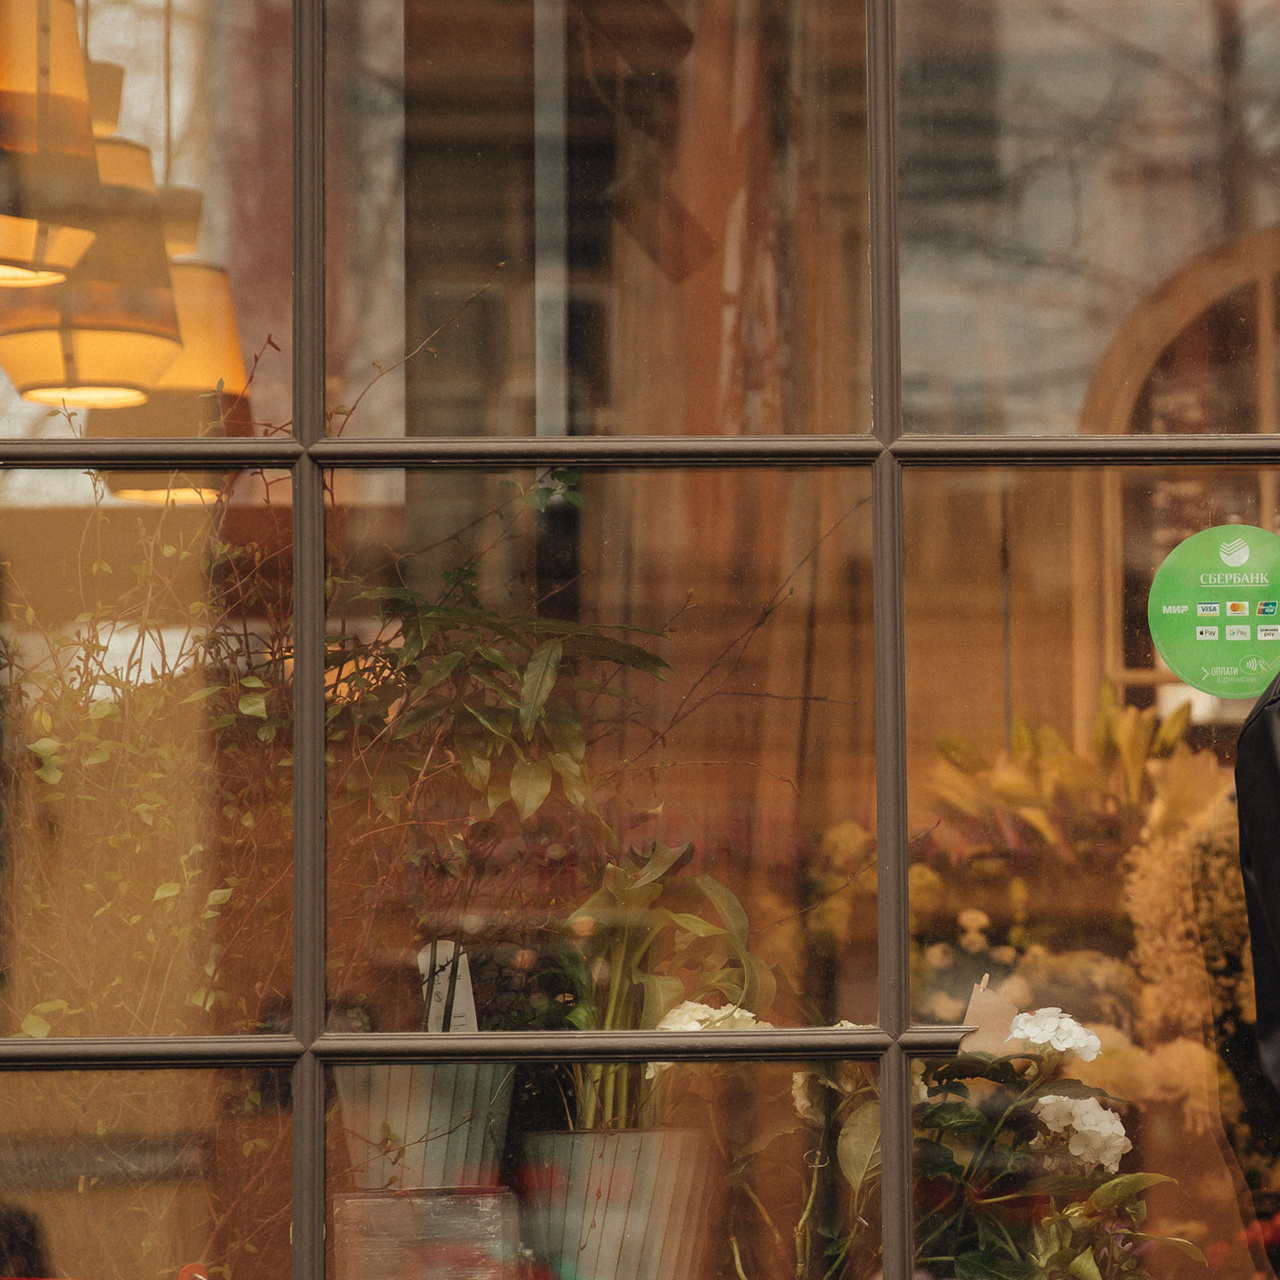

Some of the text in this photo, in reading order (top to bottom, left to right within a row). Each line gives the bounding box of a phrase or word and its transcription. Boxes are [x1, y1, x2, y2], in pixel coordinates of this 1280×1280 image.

[1200, 573, 1269, 584] СБЕРБАНК
[1162, 605, 1189, 614] МИР
[1211, 666, 1239, 676] ОПЛАТИ
